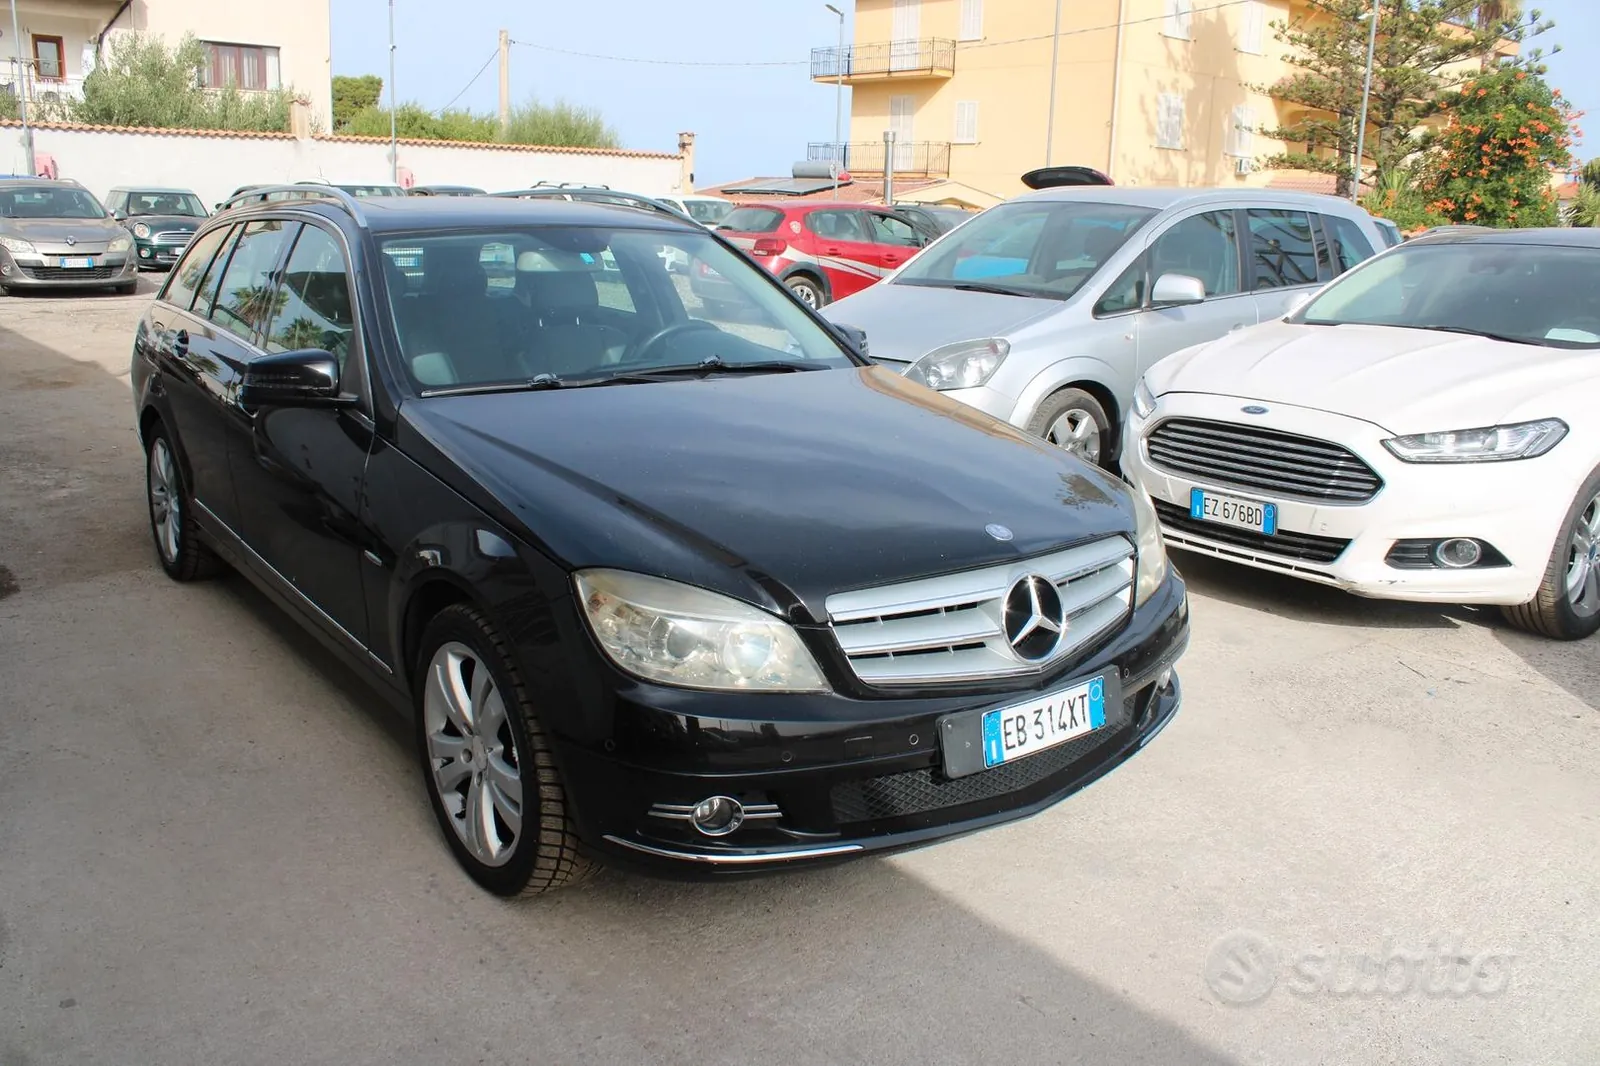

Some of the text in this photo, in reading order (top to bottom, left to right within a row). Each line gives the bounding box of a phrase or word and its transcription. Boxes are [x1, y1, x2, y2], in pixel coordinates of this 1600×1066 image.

[1203, 497, 1219, 517] EZ
[1222, 501, 1263, 526] 676BD
[1003, 714, 1028, 751] EB
[1033, 693, 1088, 740] 314XT
